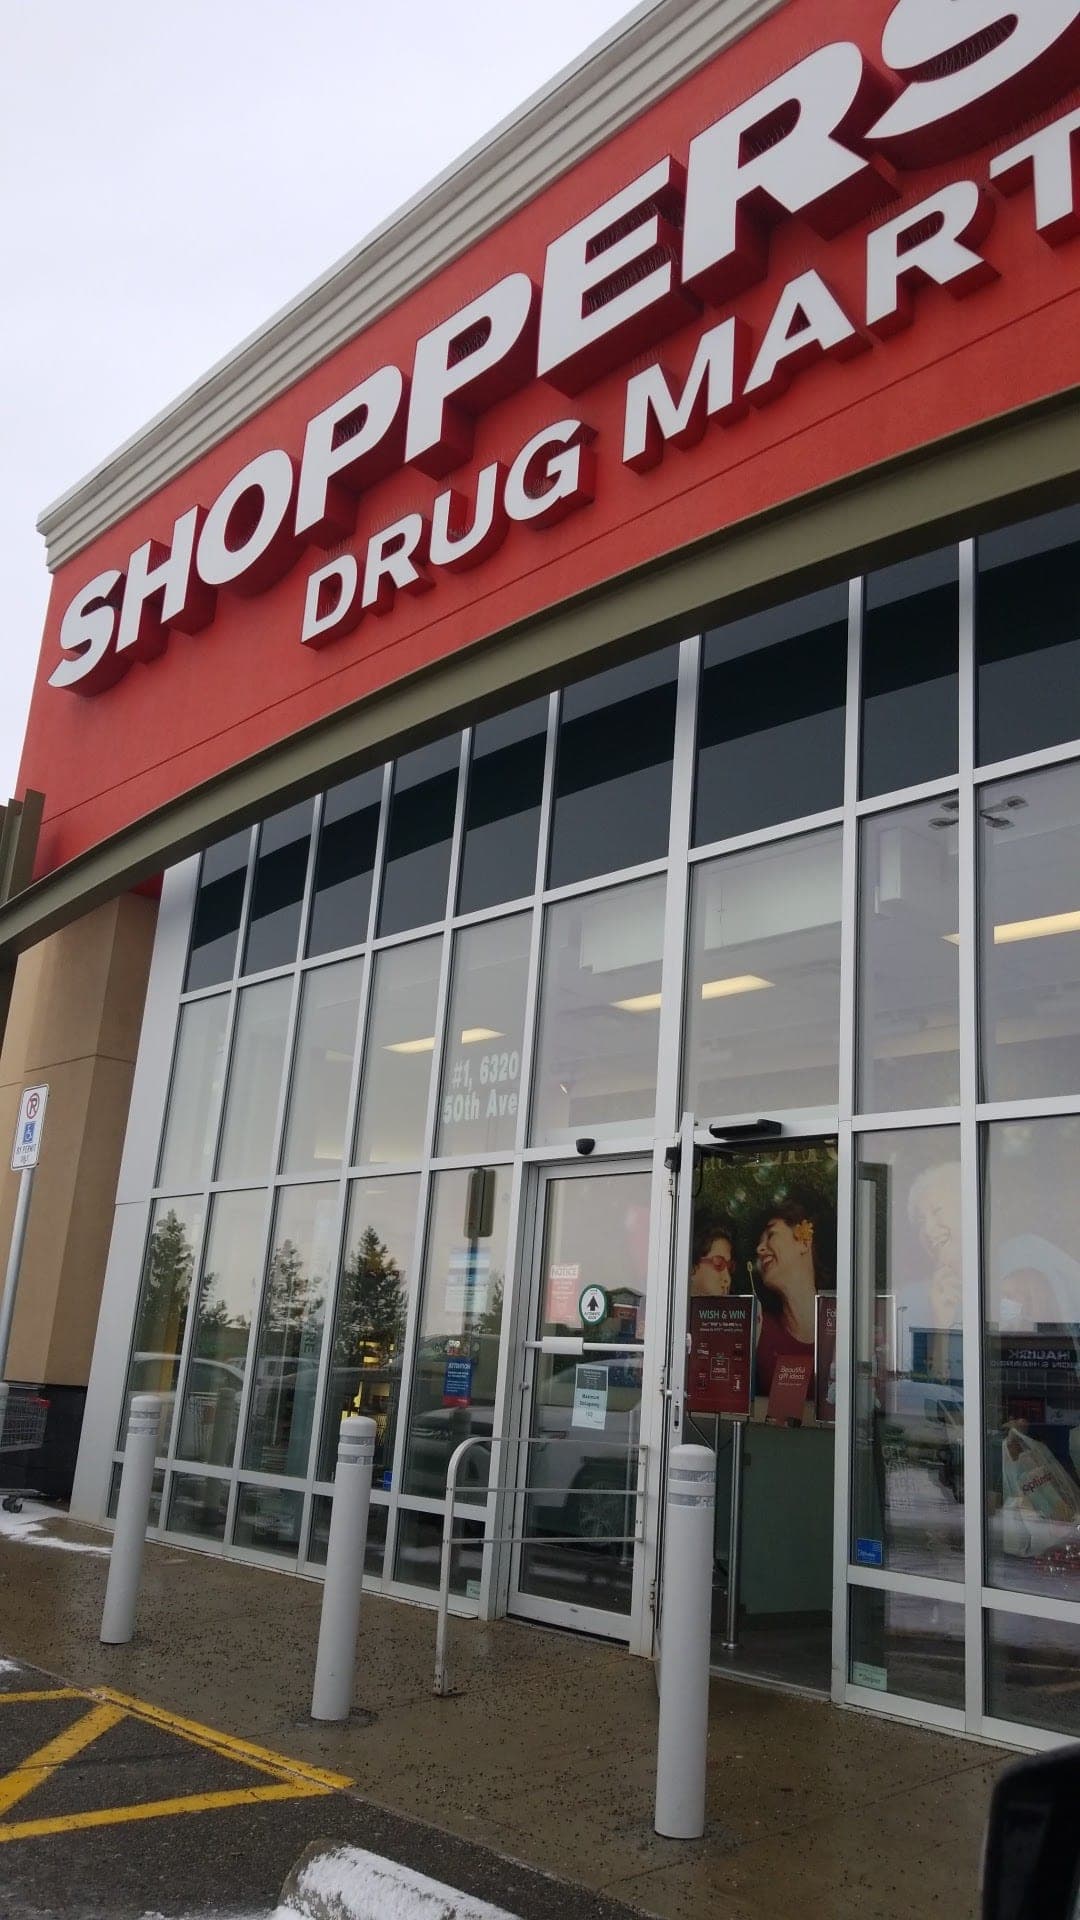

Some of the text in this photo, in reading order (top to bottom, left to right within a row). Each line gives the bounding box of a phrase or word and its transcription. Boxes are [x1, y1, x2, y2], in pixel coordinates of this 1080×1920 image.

[47, 0, 1080, 688] SHOPPERS
[301, 106, 1080, 645] DRUG MART
[480, 1050, 519, 1085] 6320
[443, 1088, 518, 1124] 50th Ave
[699, 1310, 746, 1319] WISH & WIN
